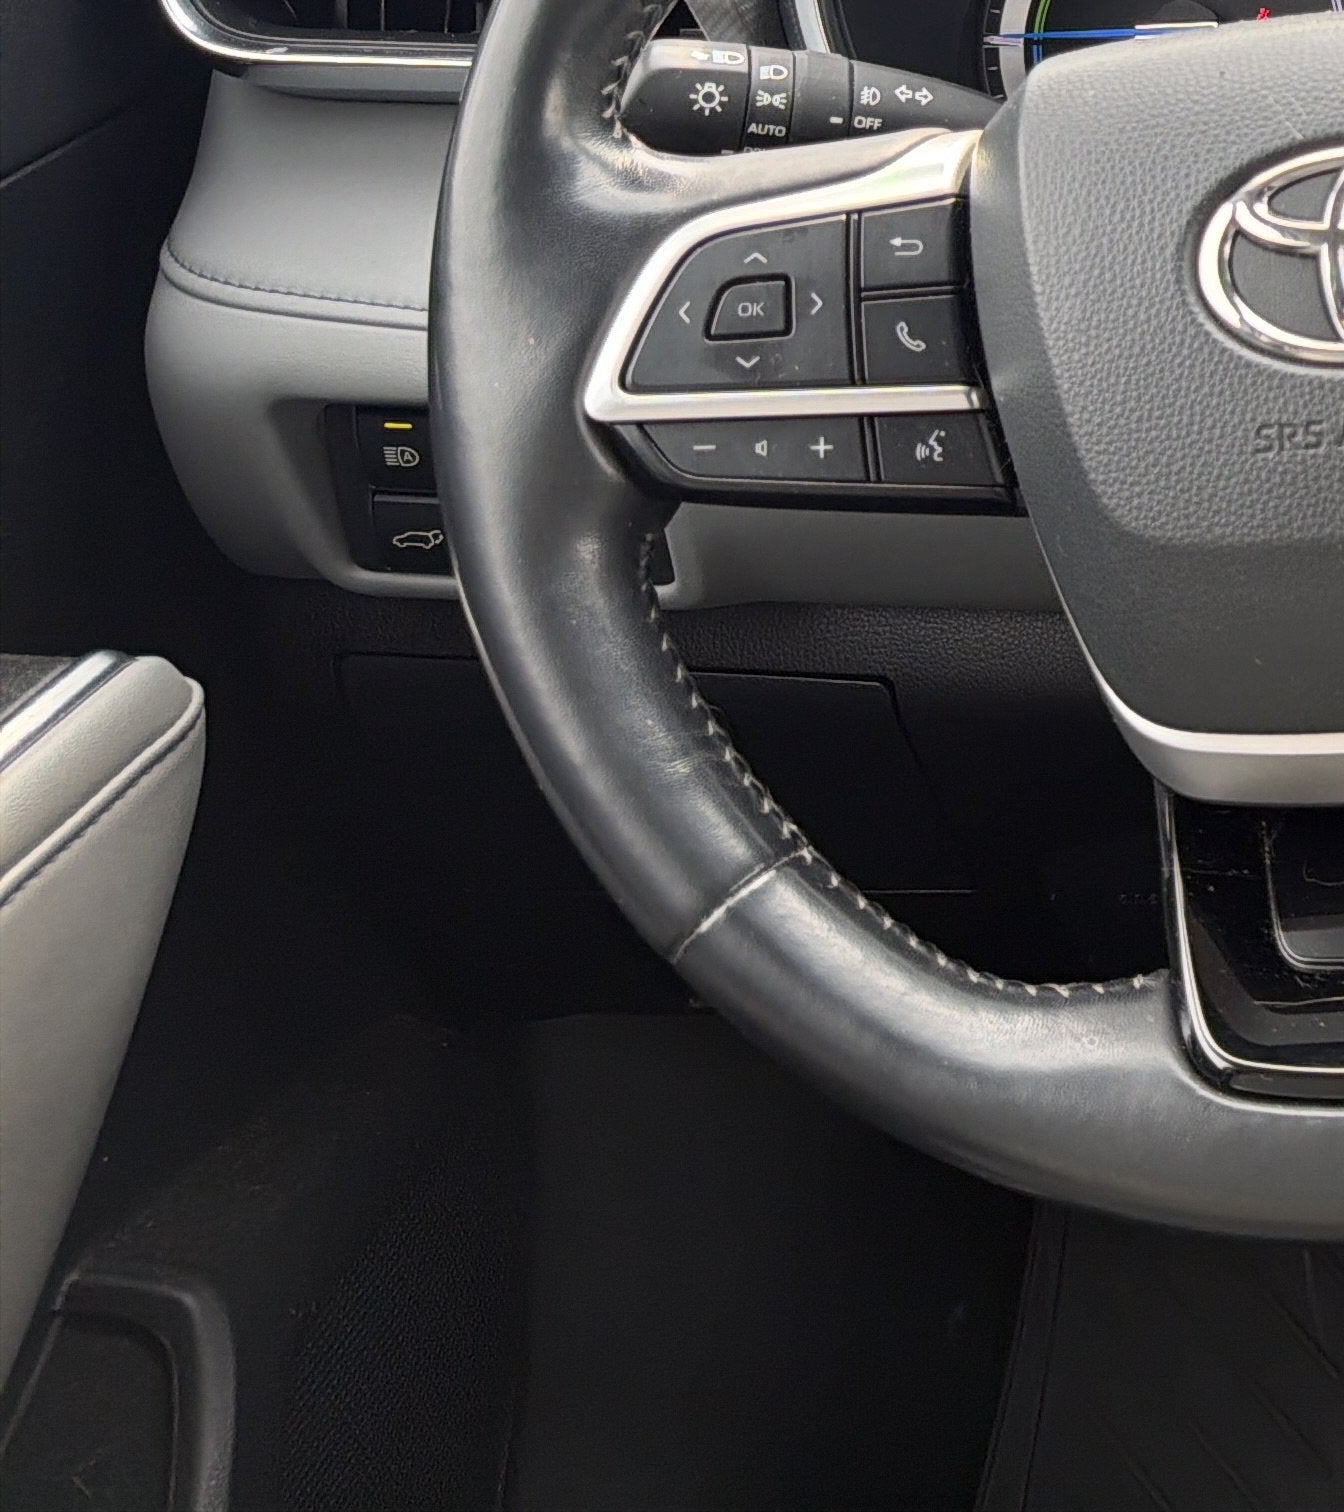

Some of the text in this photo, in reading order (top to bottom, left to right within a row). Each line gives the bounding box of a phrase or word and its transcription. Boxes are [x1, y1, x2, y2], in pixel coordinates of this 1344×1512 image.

[747, 122, 786, 137] AUTO
[853, 115, 883, 130] OFF
[737, 301, 765, 317] OK
[1254, 418, 1325, 455] SRS
